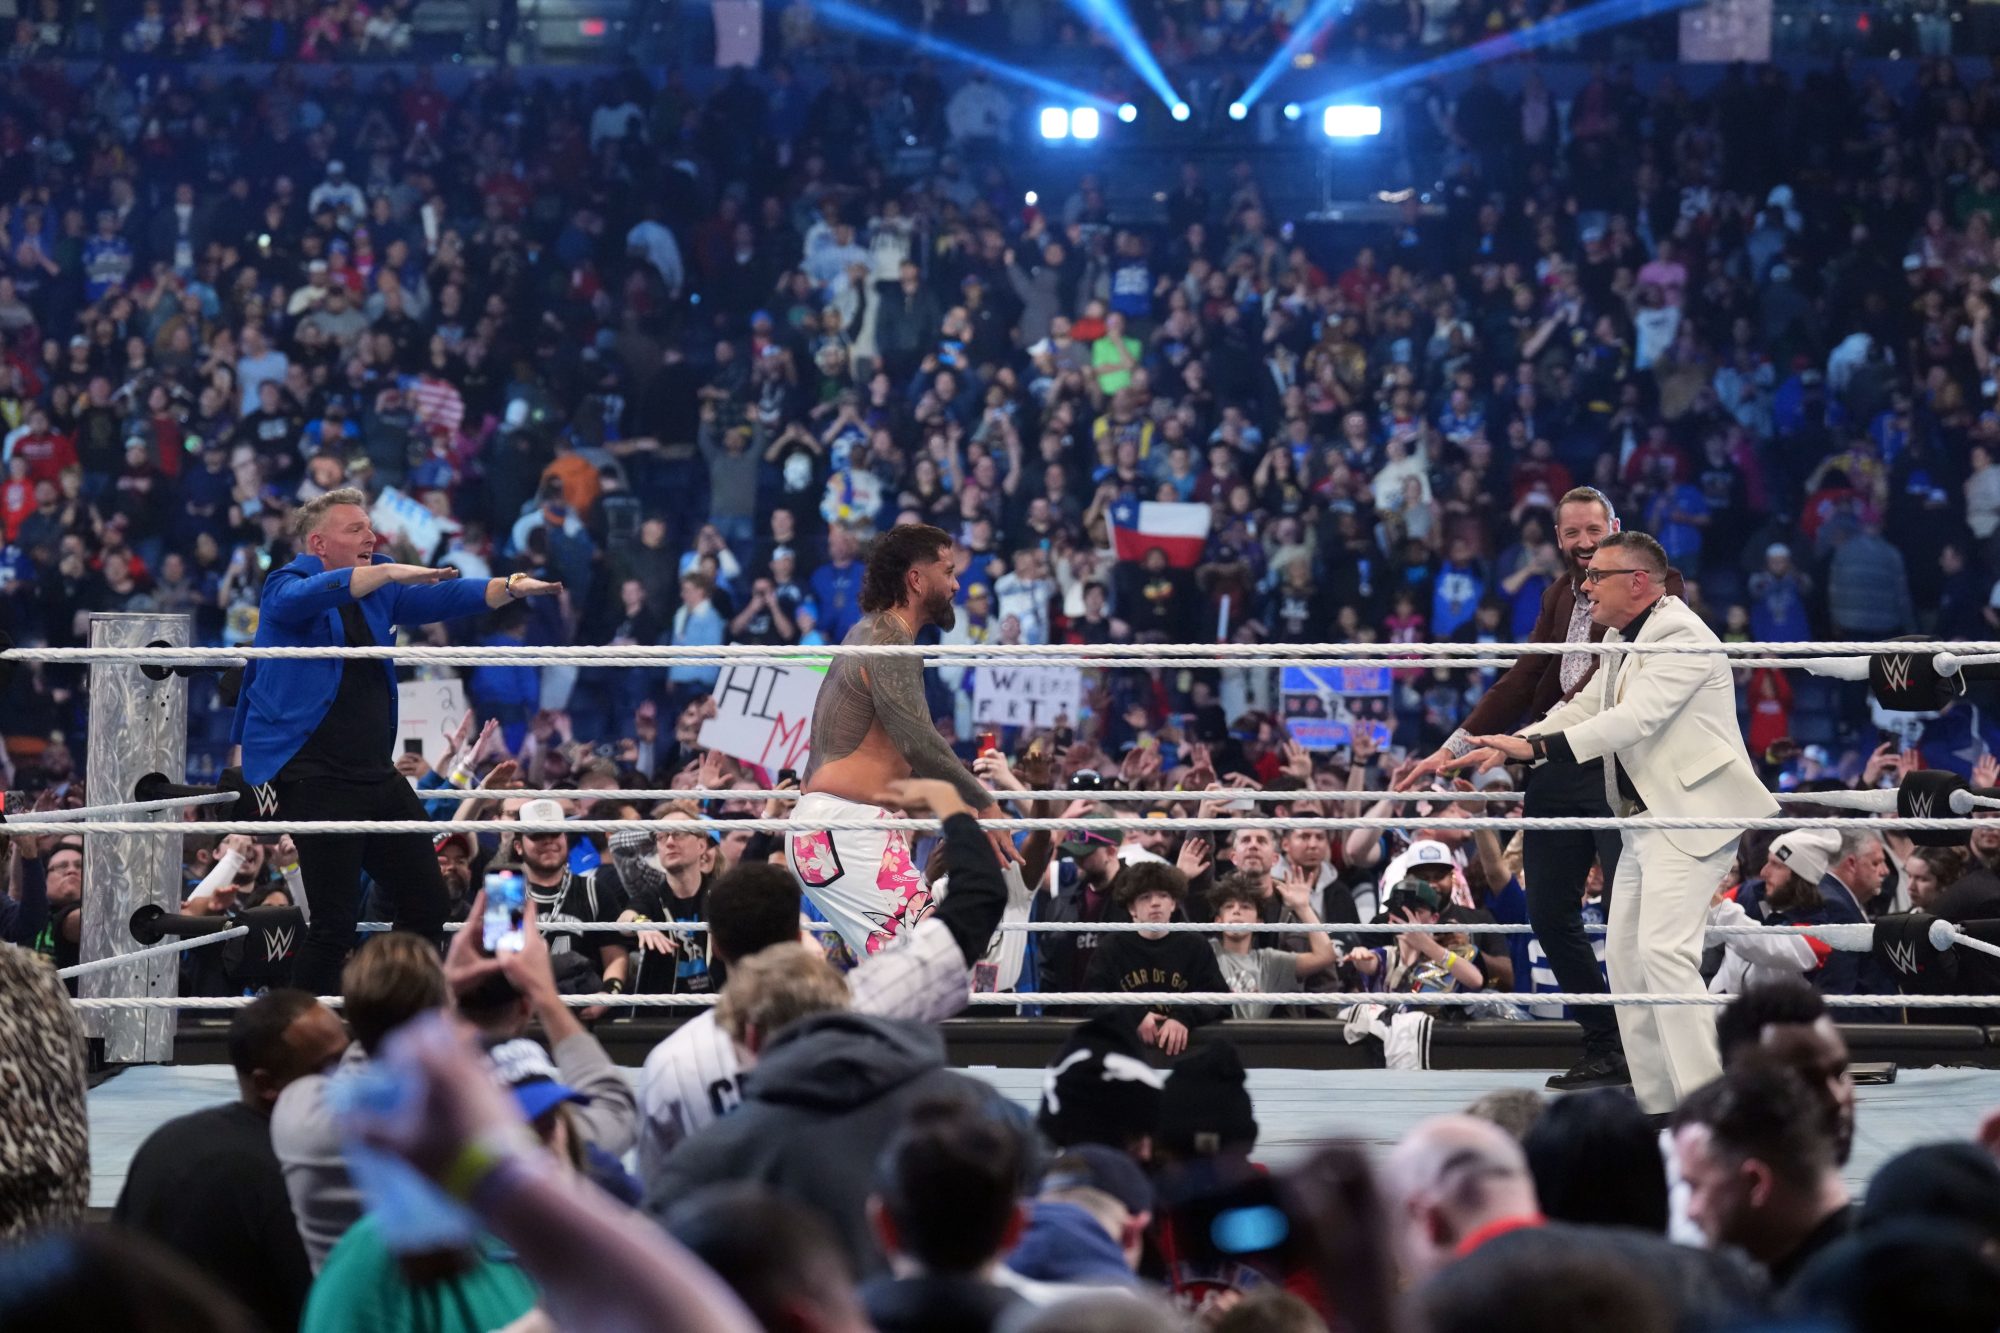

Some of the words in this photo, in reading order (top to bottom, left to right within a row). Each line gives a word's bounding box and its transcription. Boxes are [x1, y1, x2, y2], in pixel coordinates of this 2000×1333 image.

[717, 665, 789, 721] HI
[1120, 968, 1148, 992] FEAR
[1152, 967, 1166, 984] OF
